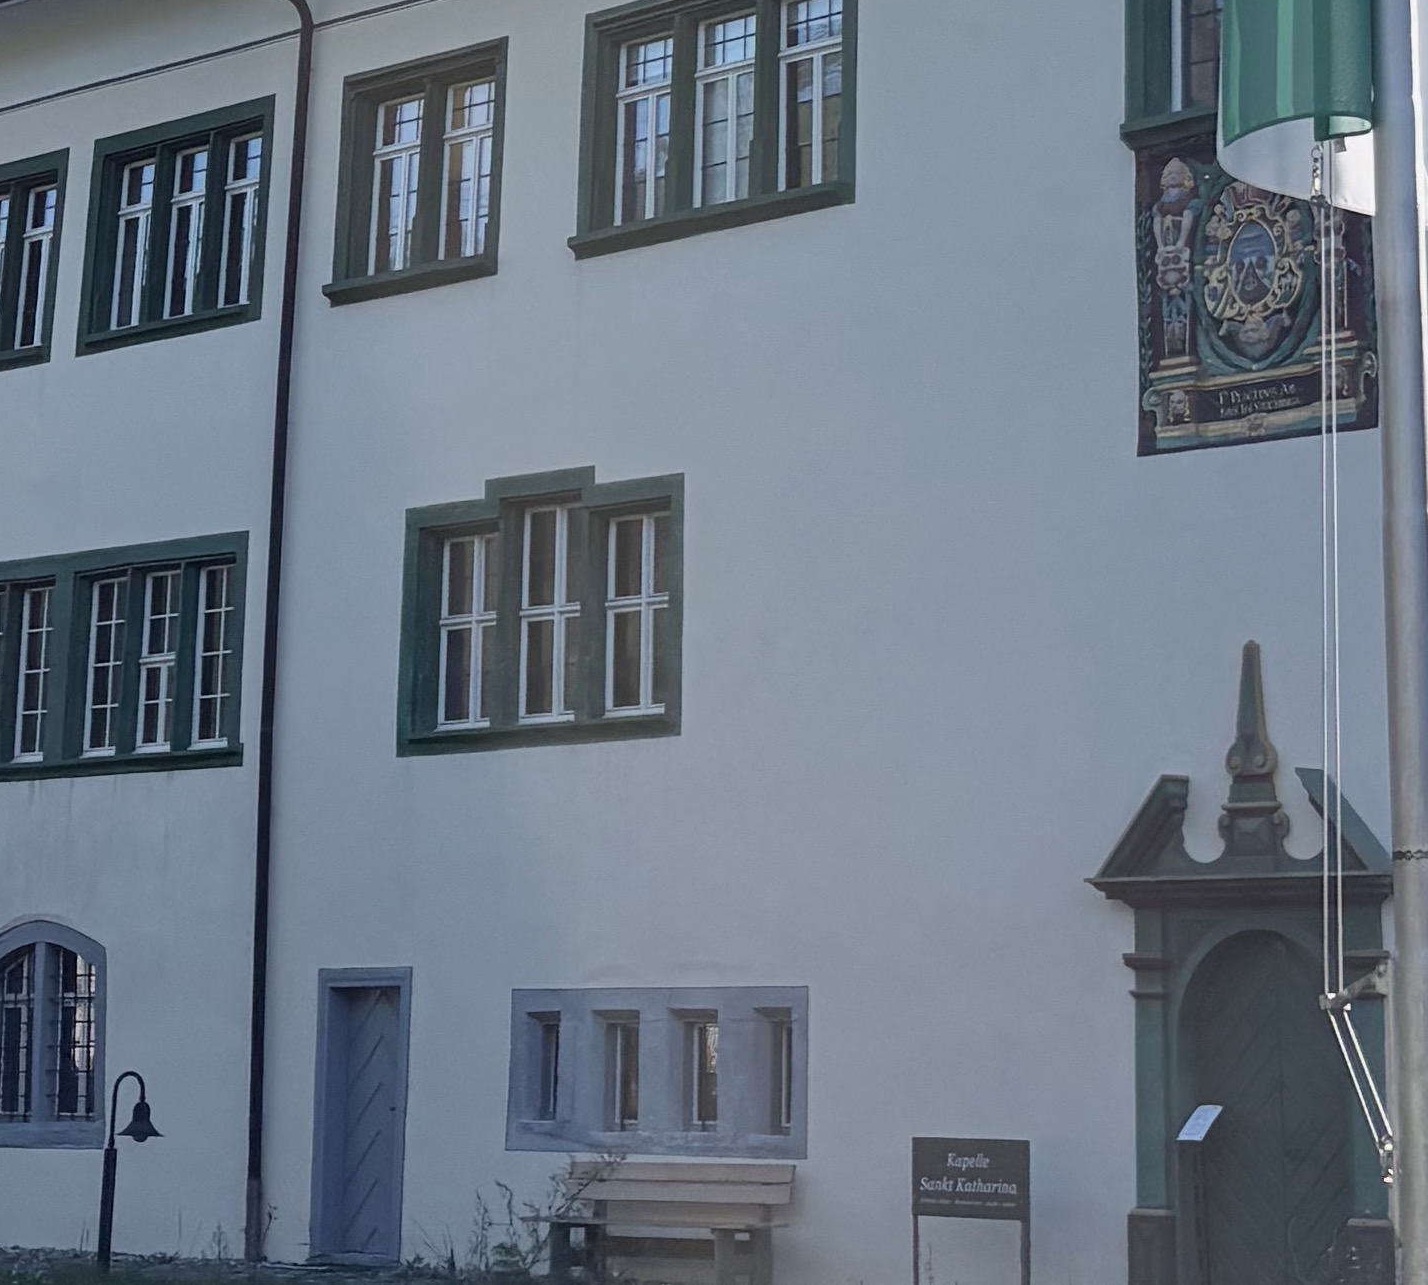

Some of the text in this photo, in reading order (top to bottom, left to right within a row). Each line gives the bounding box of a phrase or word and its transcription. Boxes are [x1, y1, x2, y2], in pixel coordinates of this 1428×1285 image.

[947, 1152, 989, 1171] Kapelle
[920, 1176, 1017, 1195] Sankt Katharina
